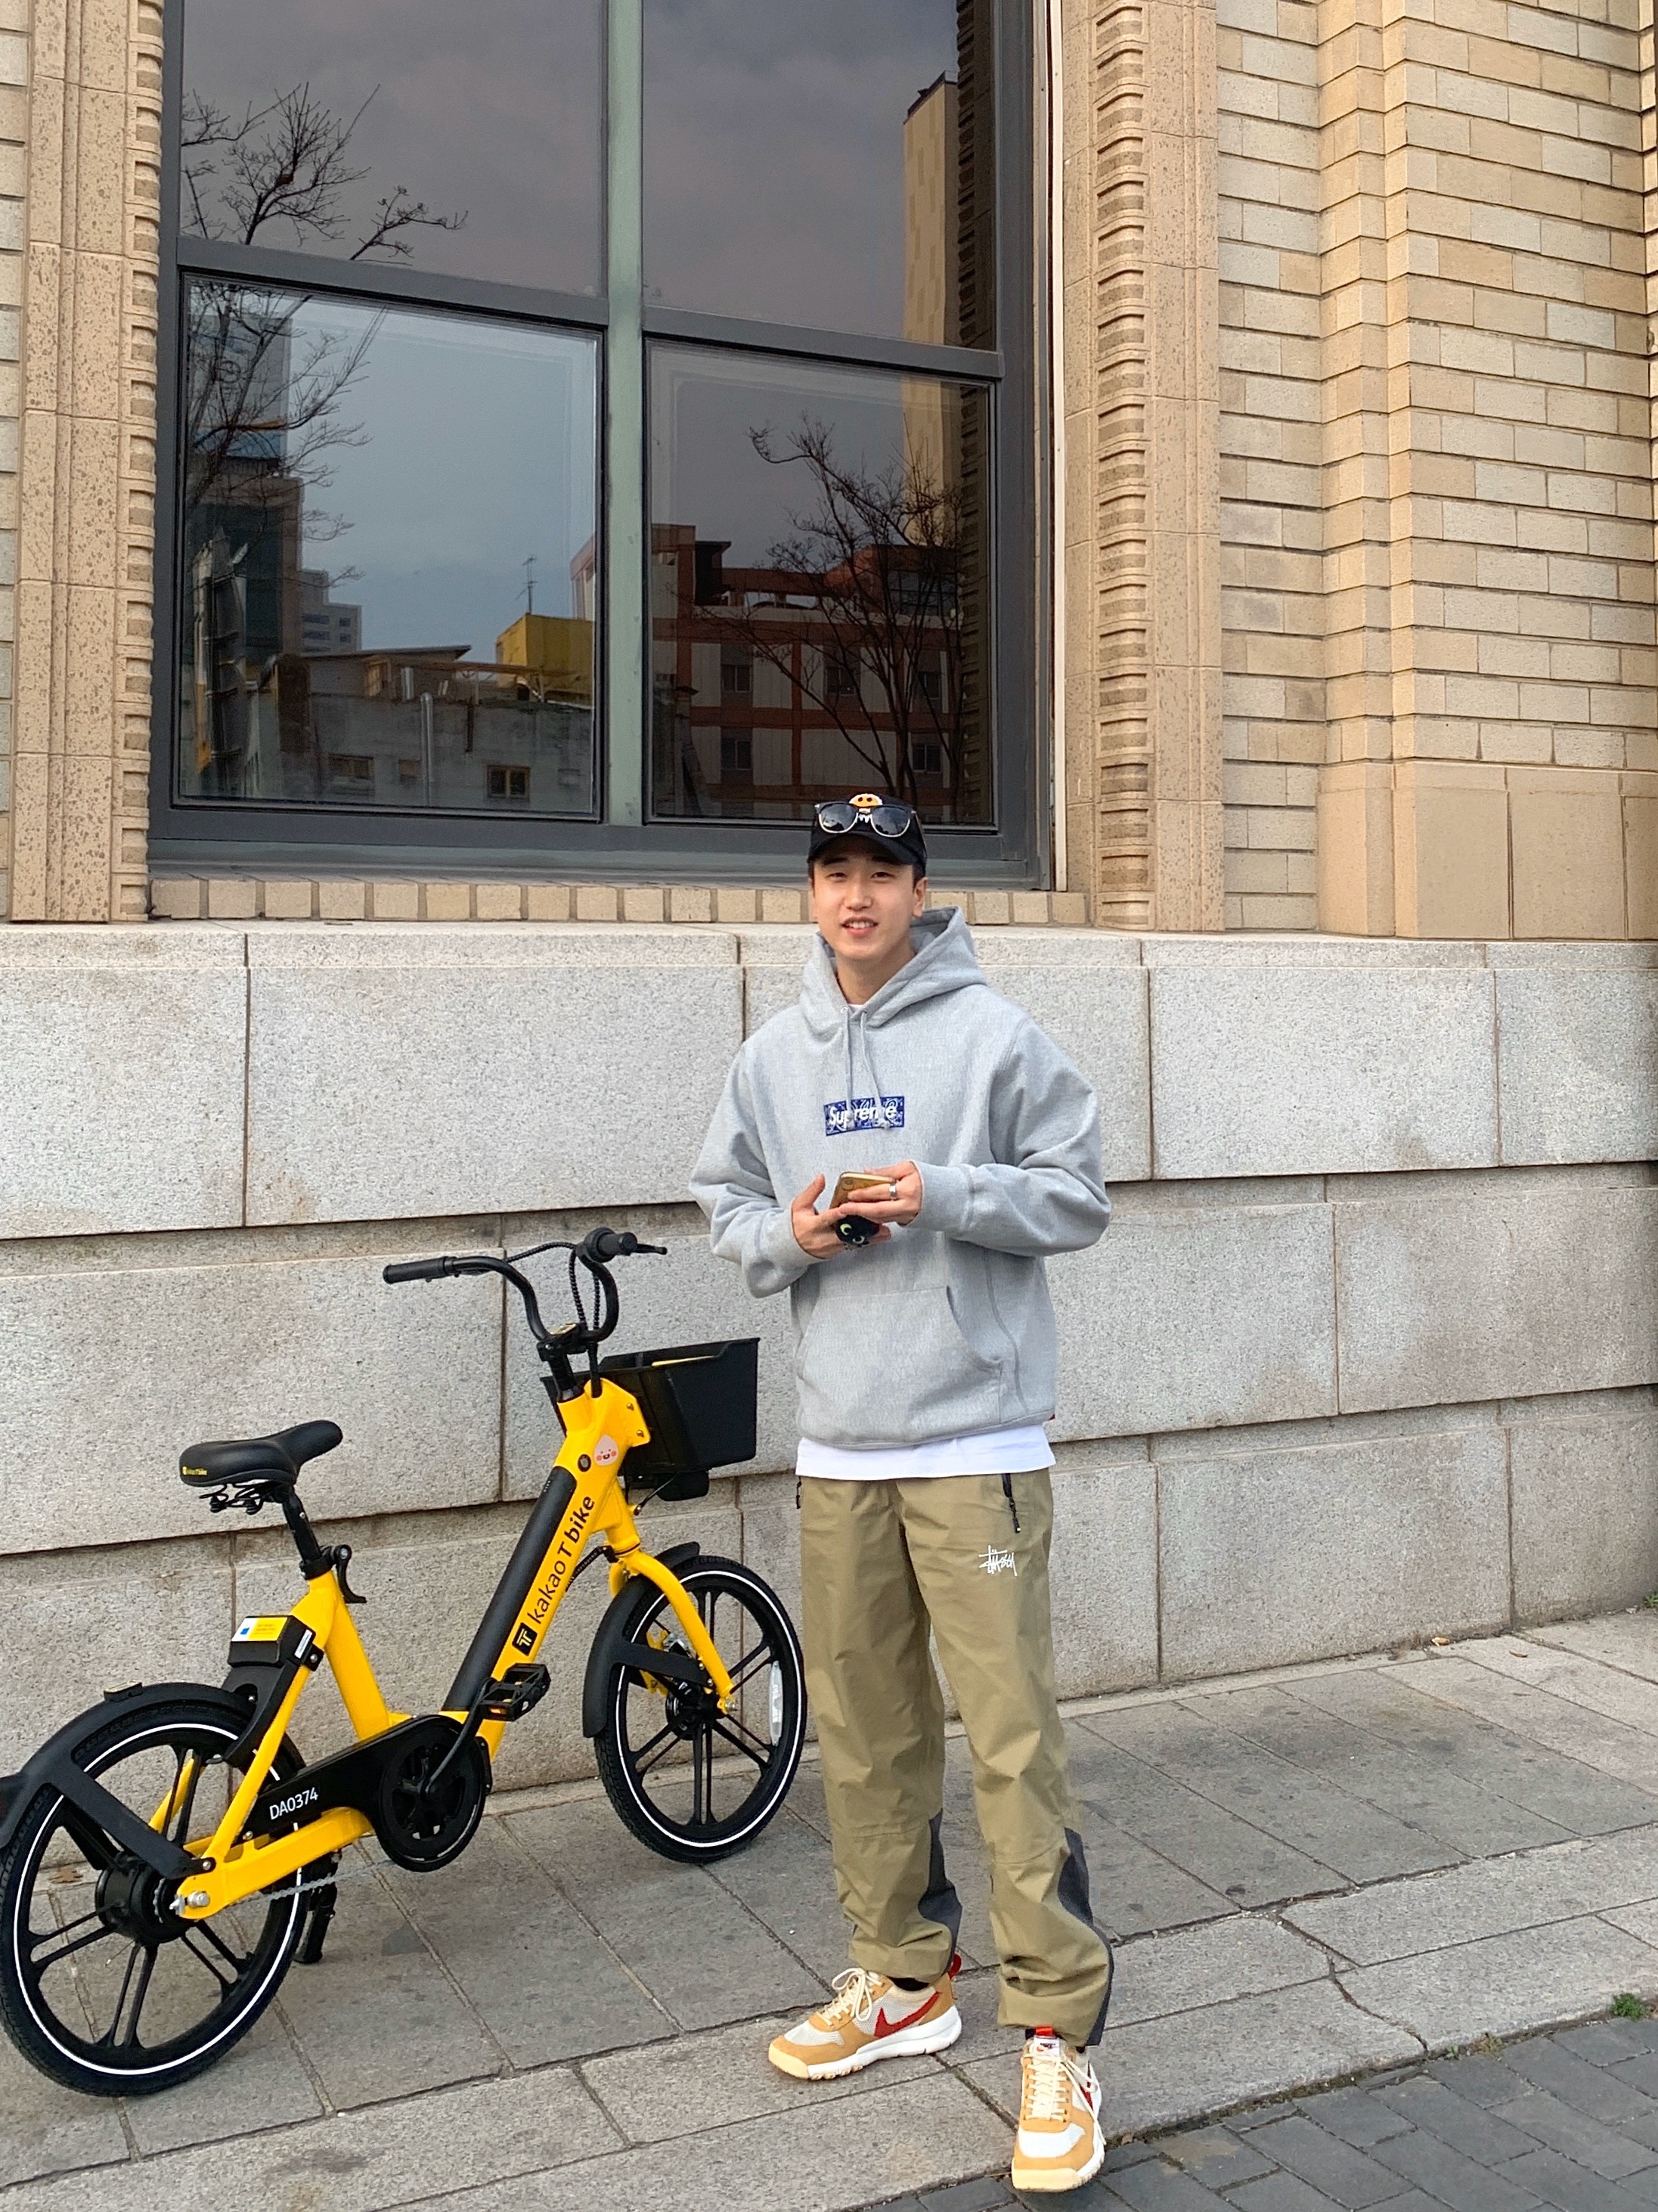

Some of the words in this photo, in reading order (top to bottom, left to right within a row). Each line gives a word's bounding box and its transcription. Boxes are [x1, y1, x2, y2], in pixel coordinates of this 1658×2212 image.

[563, 1495, 595, 1544] bike
[557, 1540, 572, 1558] T
[527, 1559, 566, 1624] kakao
[269, 1786, 319, 1820] DA0374
